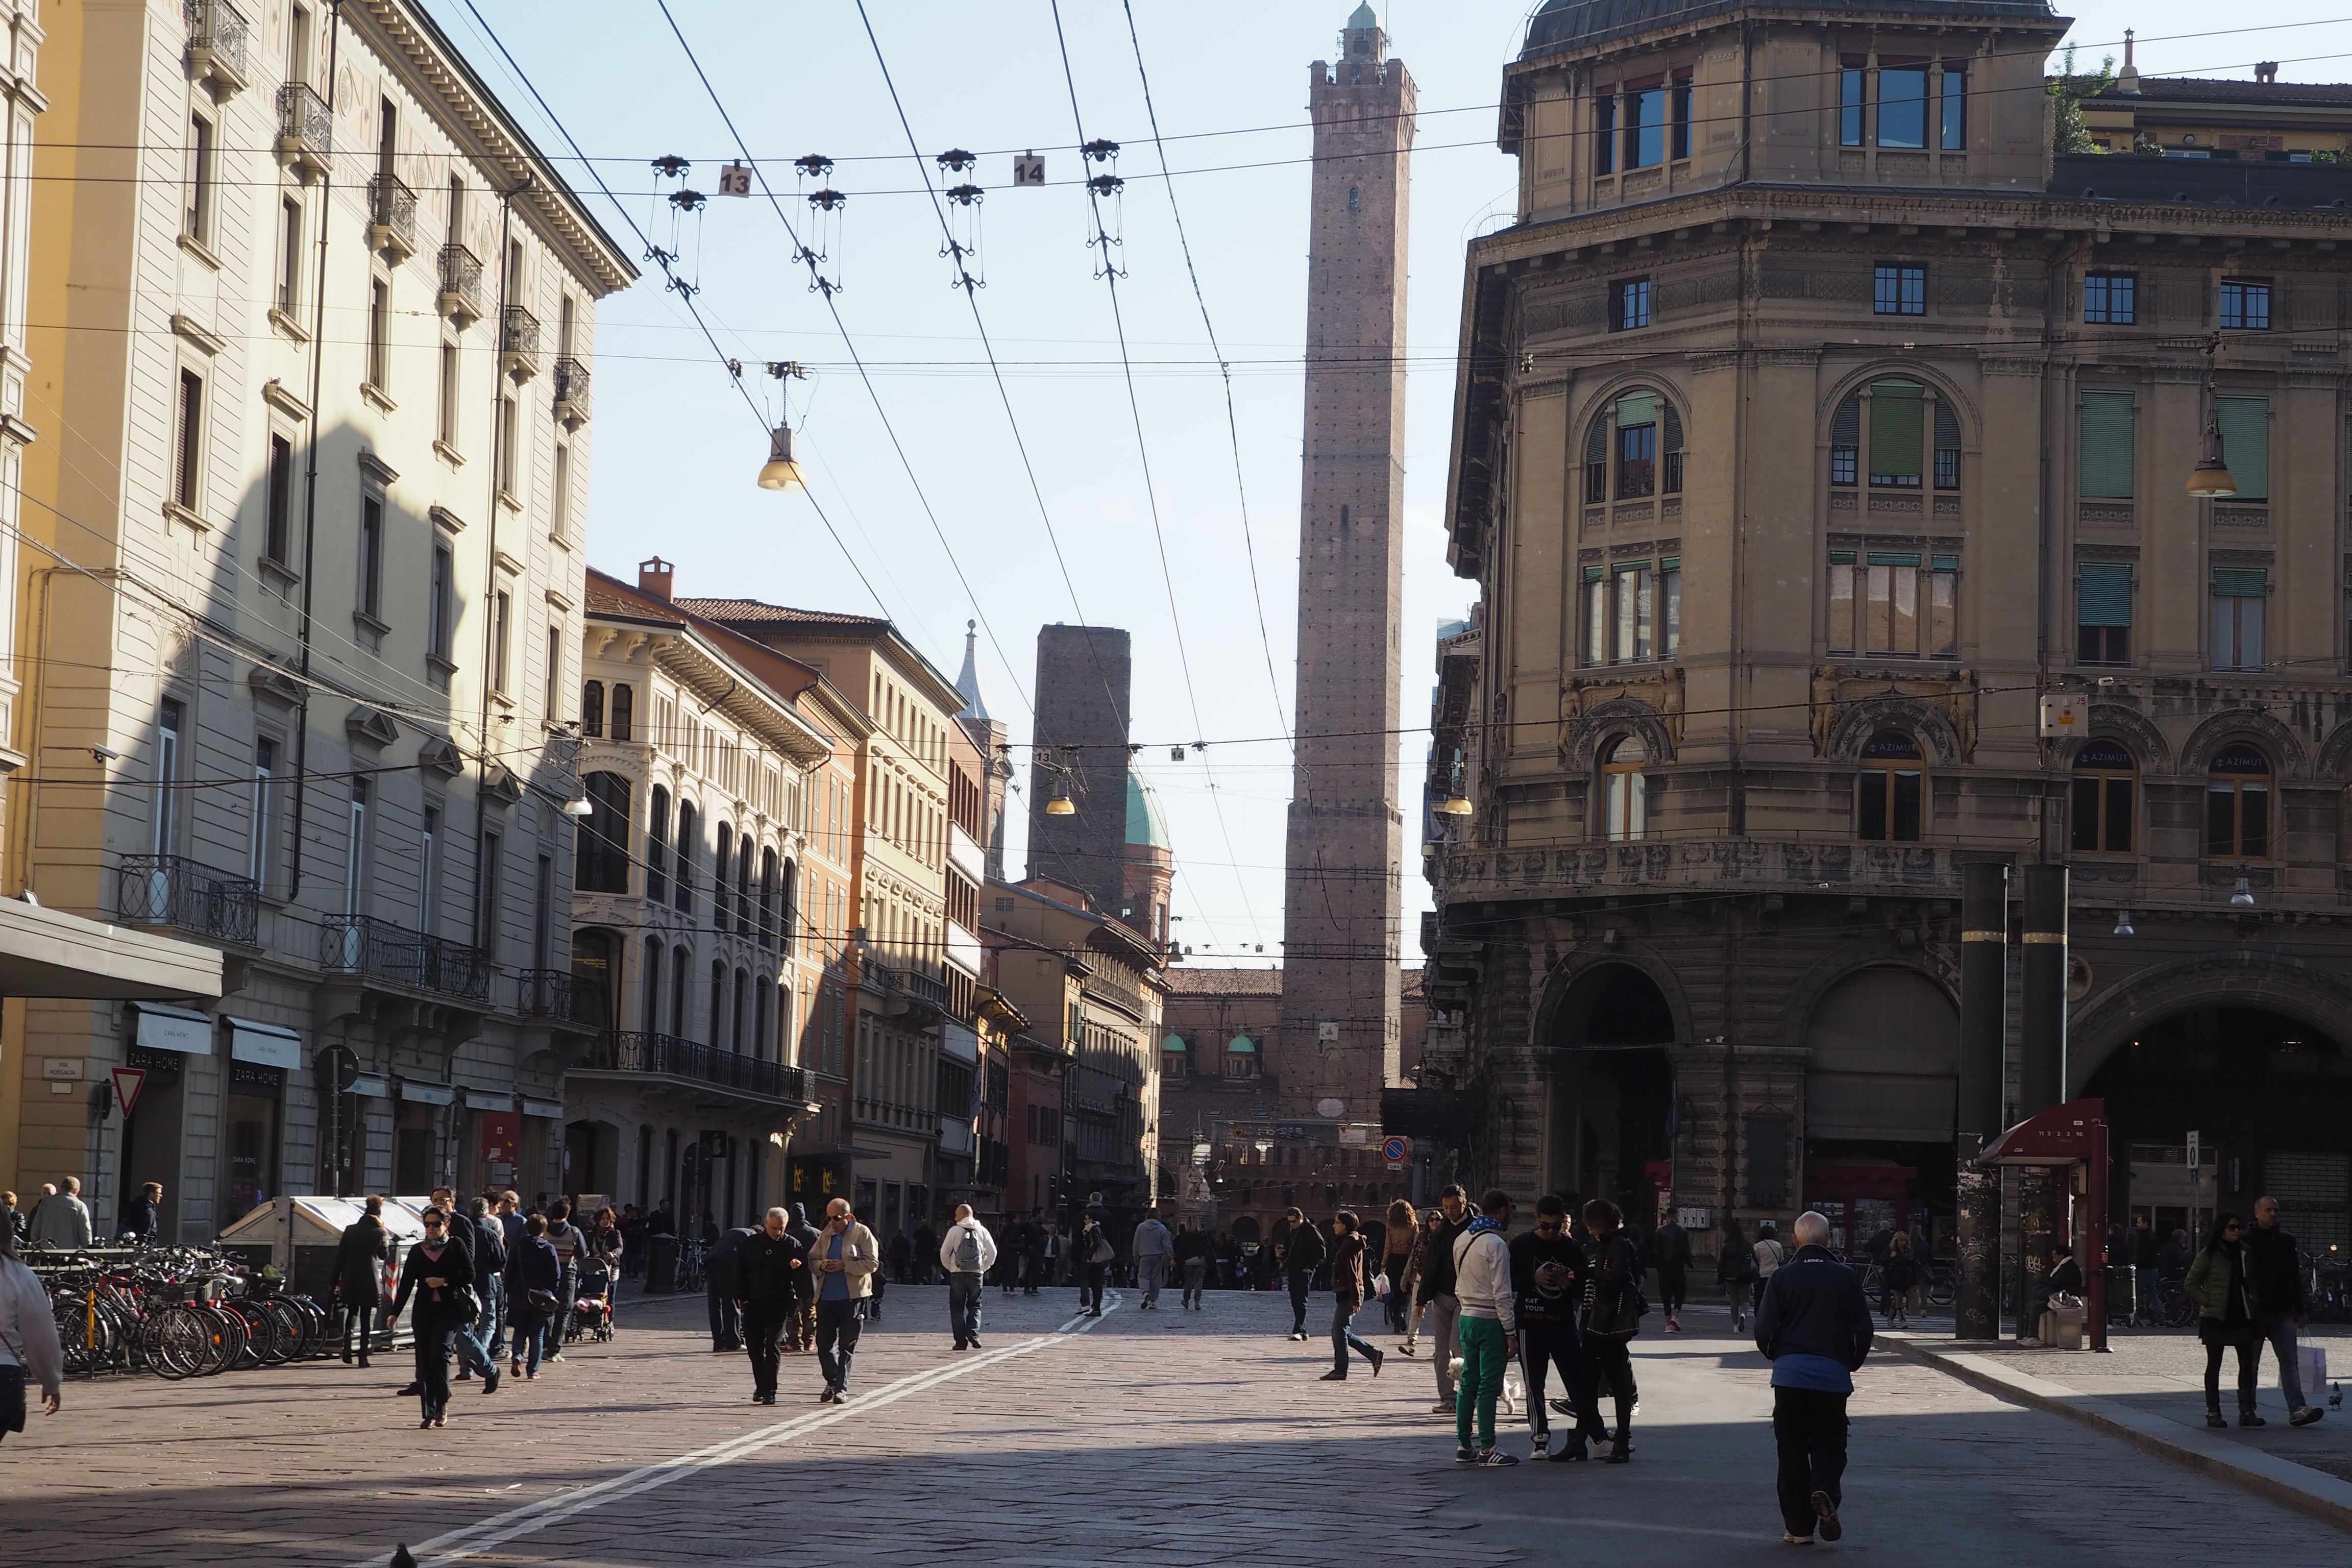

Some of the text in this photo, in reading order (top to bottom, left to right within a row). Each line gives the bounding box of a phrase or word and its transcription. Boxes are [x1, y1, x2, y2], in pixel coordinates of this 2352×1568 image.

[1015, 163, 1044, 182] 14
[721, 173, 750, 194] 13
[1879, 743, 1916, 751] AZIMUT
[2091, 753, 2127, 762] AZIMUT
[2226, 758, 2262, 766] AZIMUT
[130, 1053, 179, 1070] ZARA HOME
[235, 1069, 278, 1086] ZARA HOME
